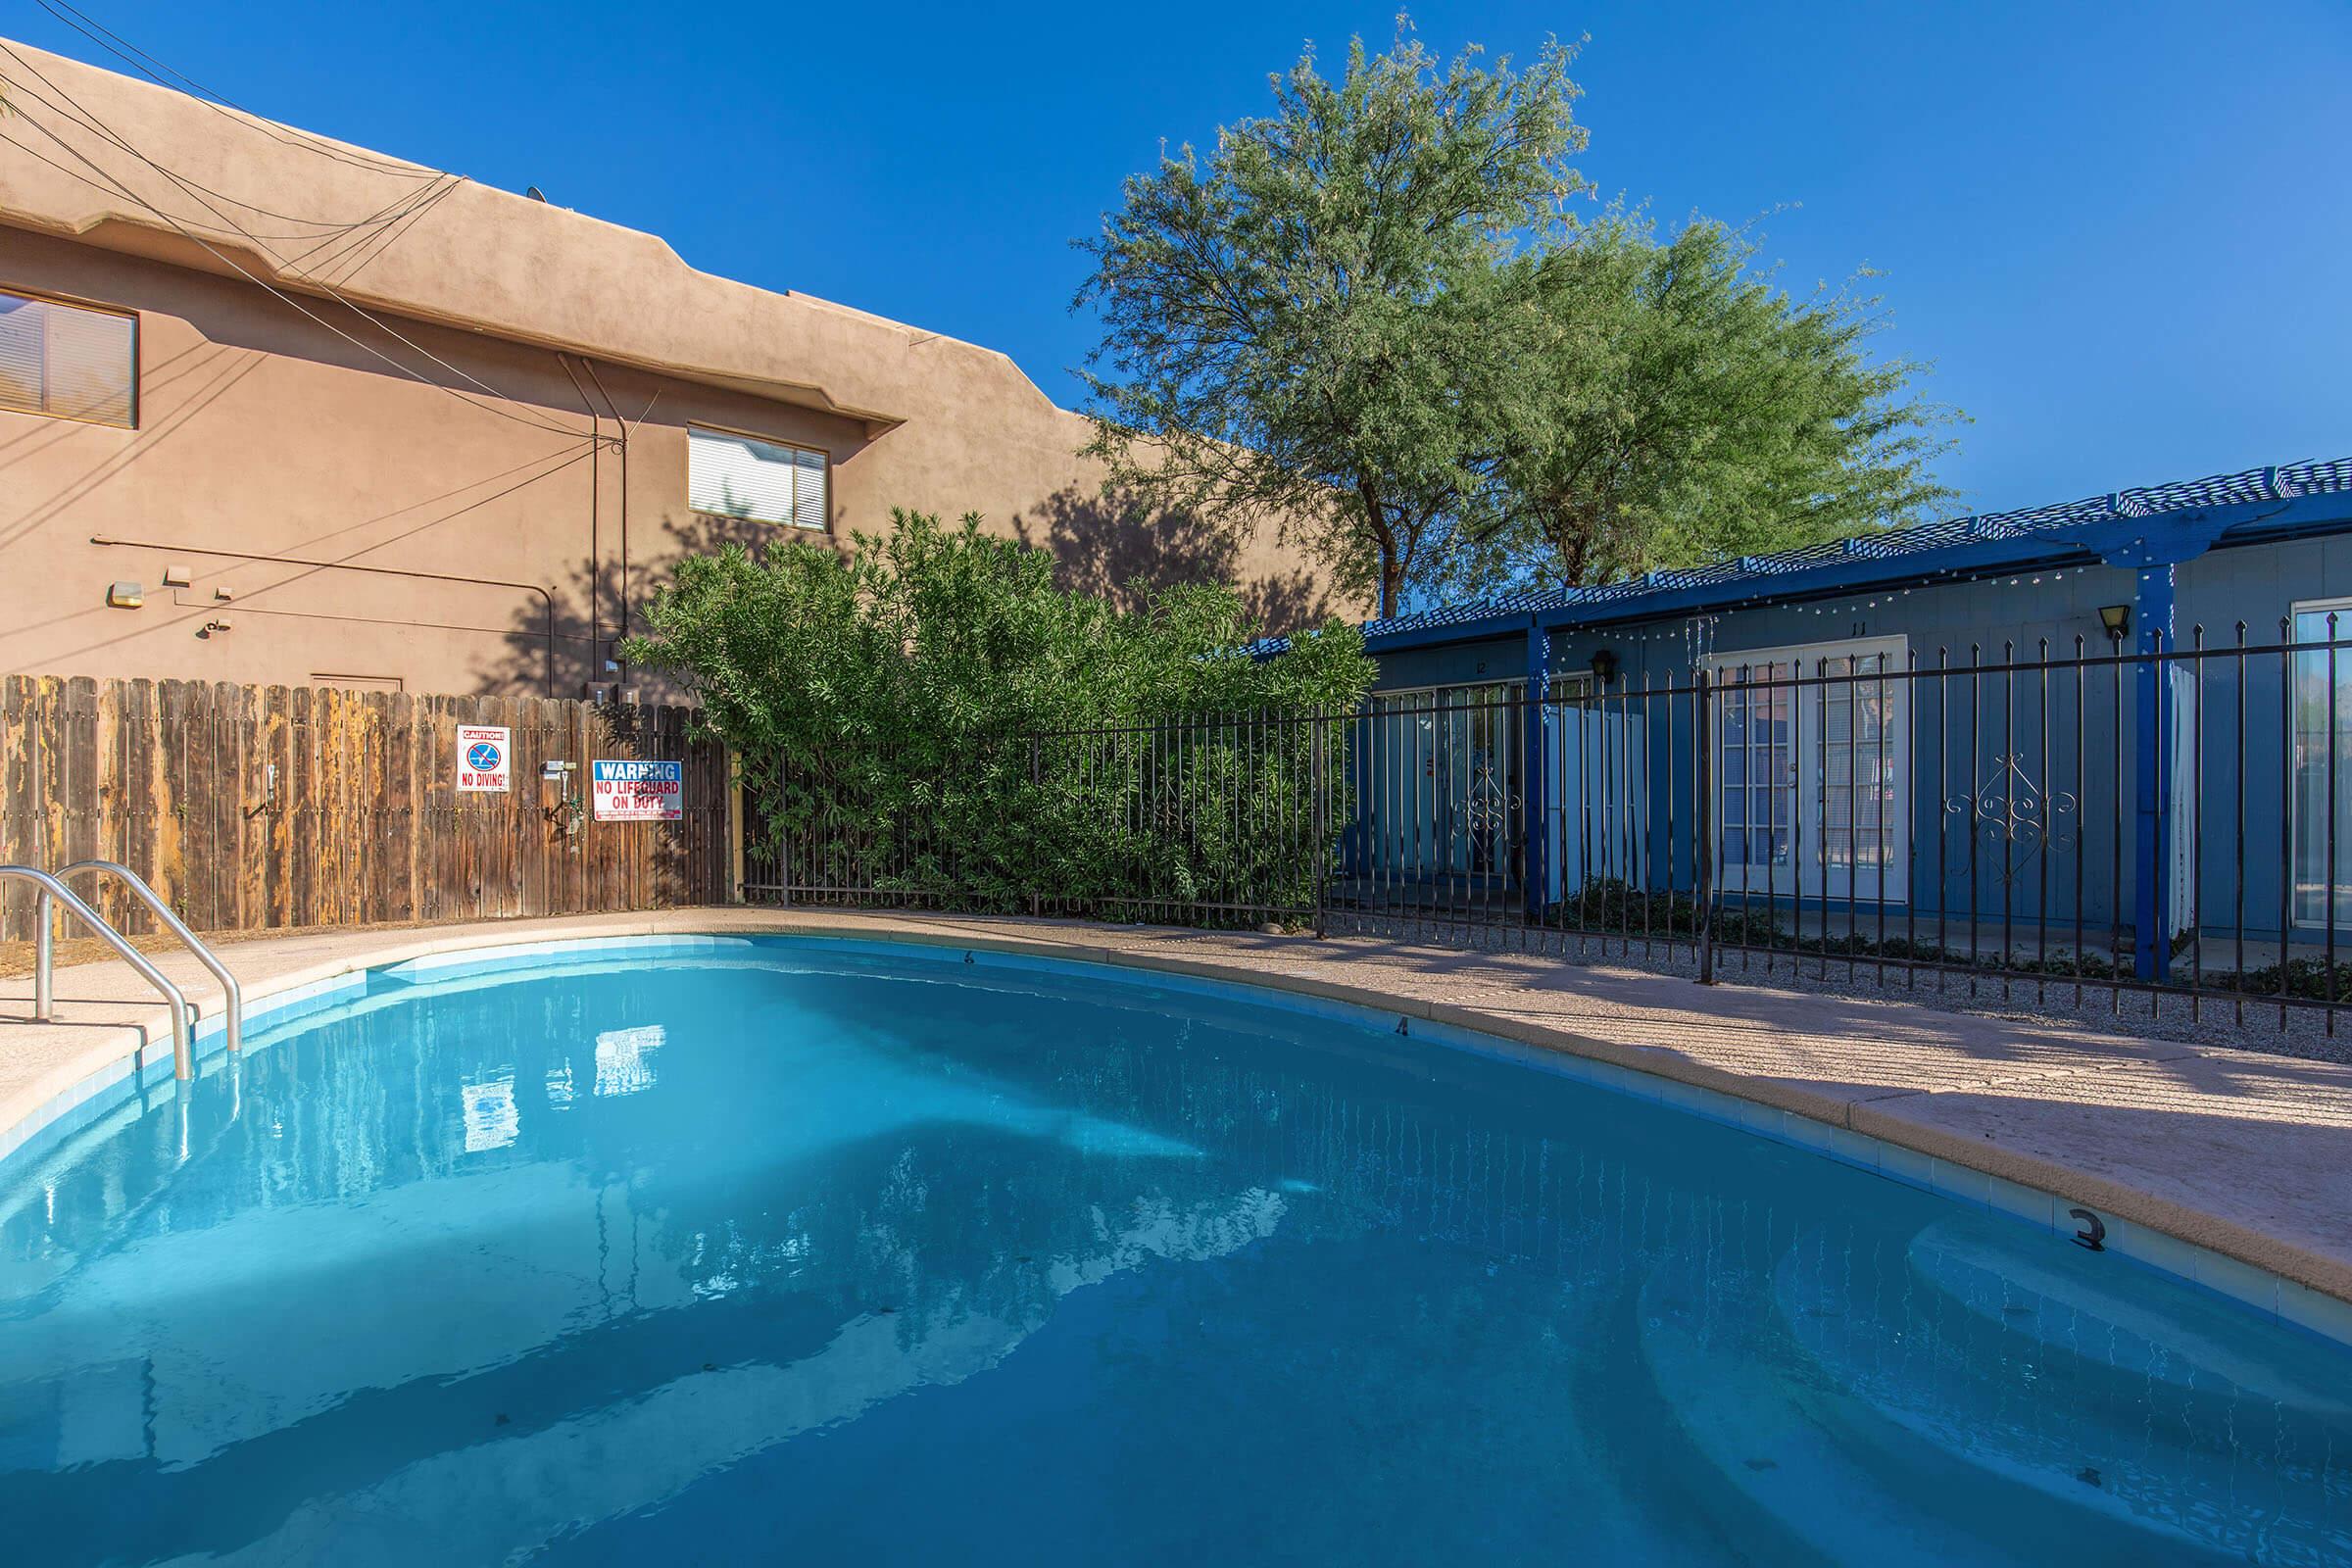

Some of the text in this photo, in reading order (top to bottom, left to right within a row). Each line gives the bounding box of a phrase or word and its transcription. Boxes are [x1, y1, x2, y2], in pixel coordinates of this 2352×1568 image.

[464, 731, 504, 740] CAUTION!
[601, 762, 675, 780] WARNING
[463, 773, 506, 786] NO DIVING!
[596, 781, 679, 795] NO LIFEGUARD
[612, 796, 664, 809] ON DUTY
